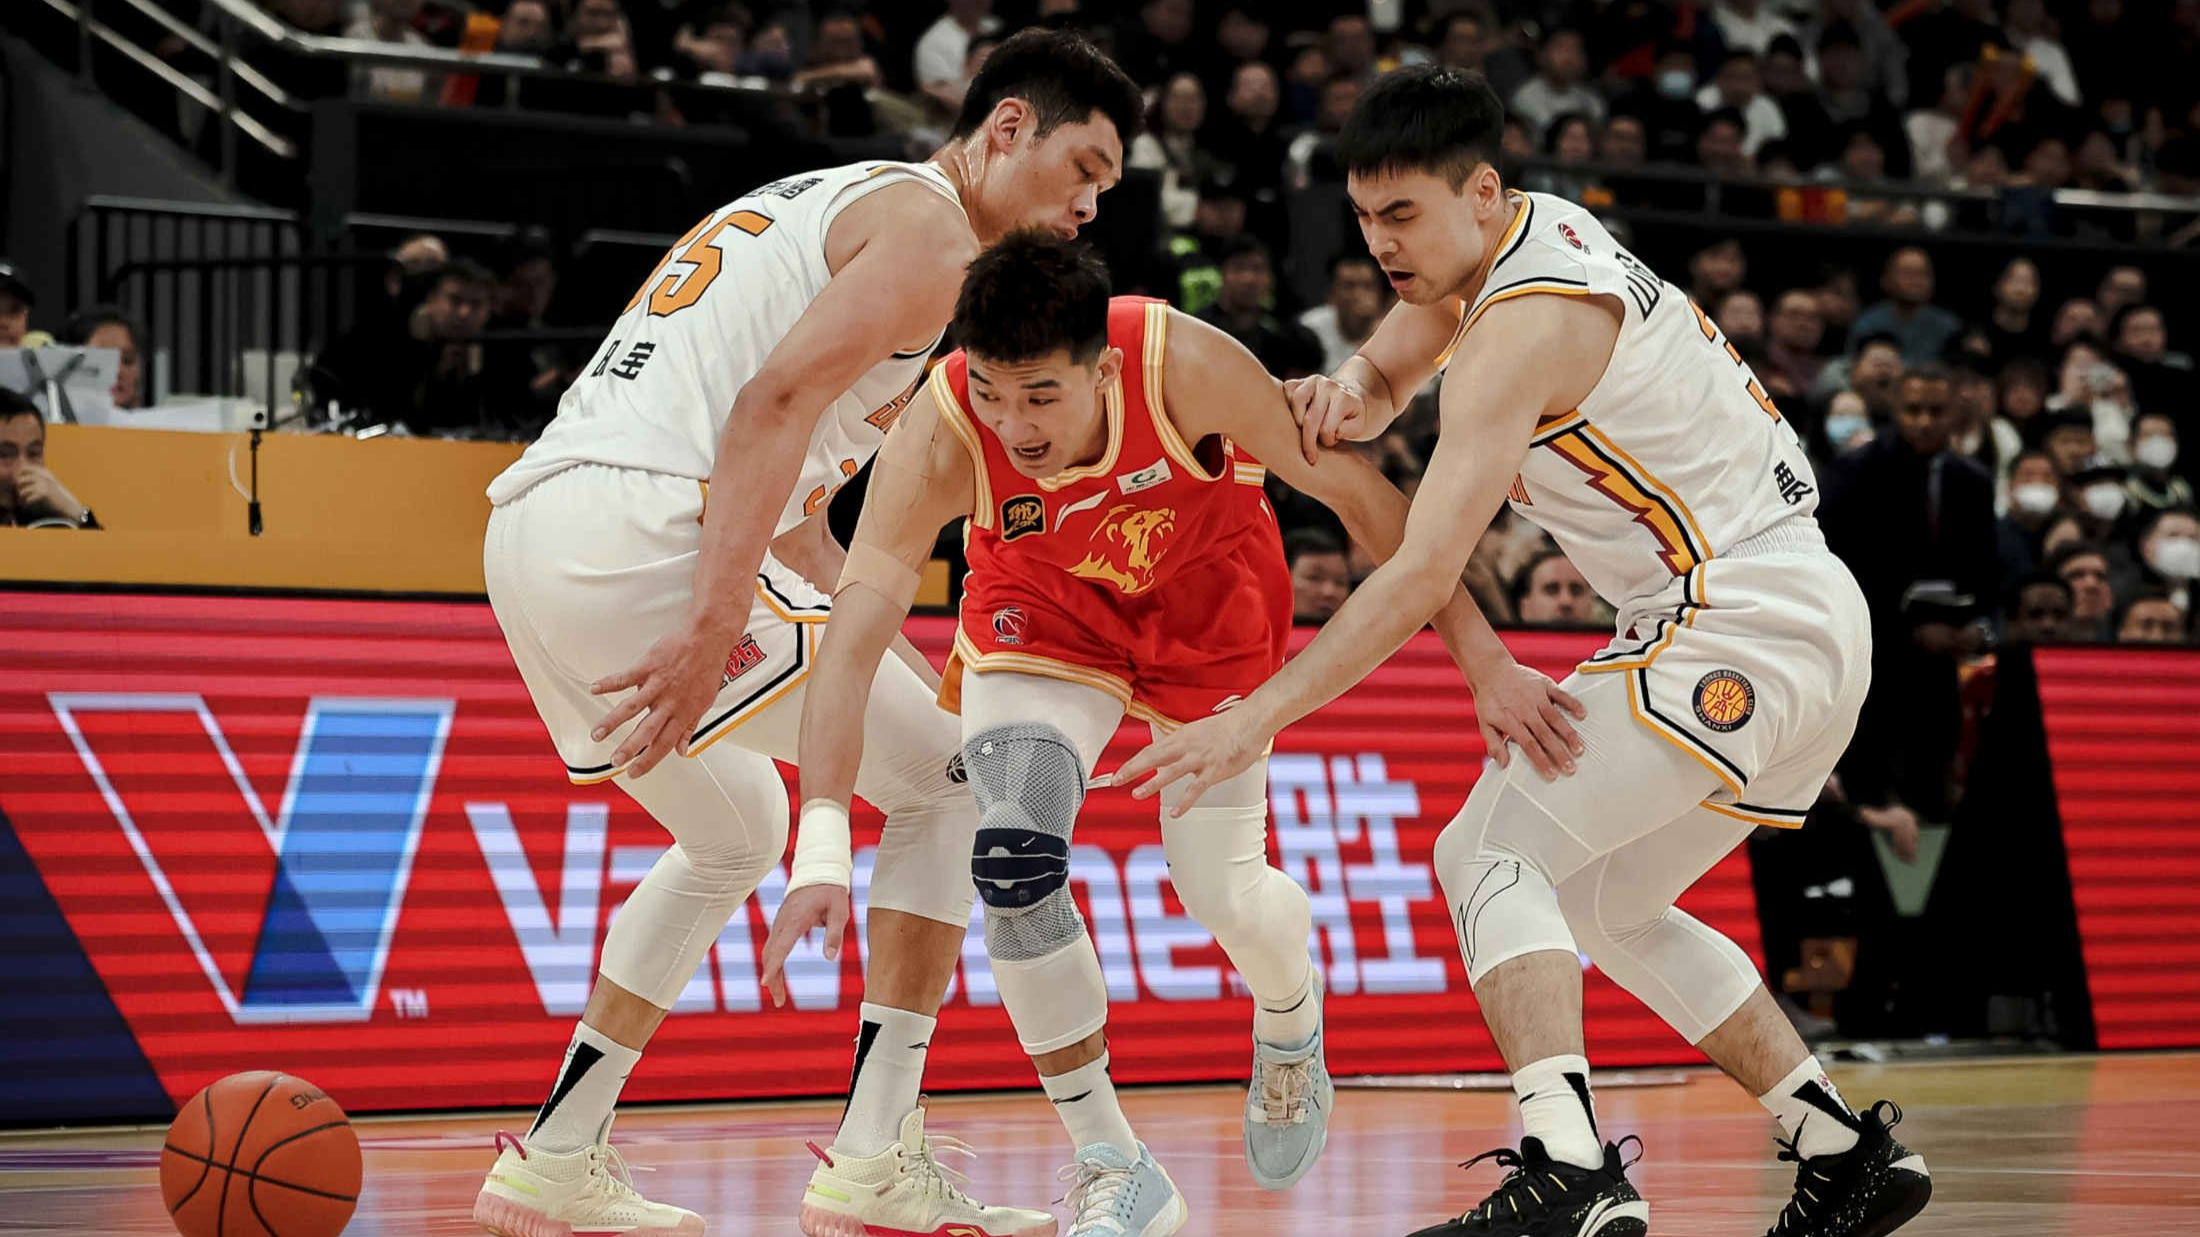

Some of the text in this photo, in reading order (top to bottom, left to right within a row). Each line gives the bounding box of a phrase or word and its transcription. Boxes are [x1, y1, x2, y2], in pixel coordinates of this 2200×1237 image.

[719, 632, 767, 691] 西
[1267, 752, 1449, 996] 胜
[389, 988, 429, 1018] TM
